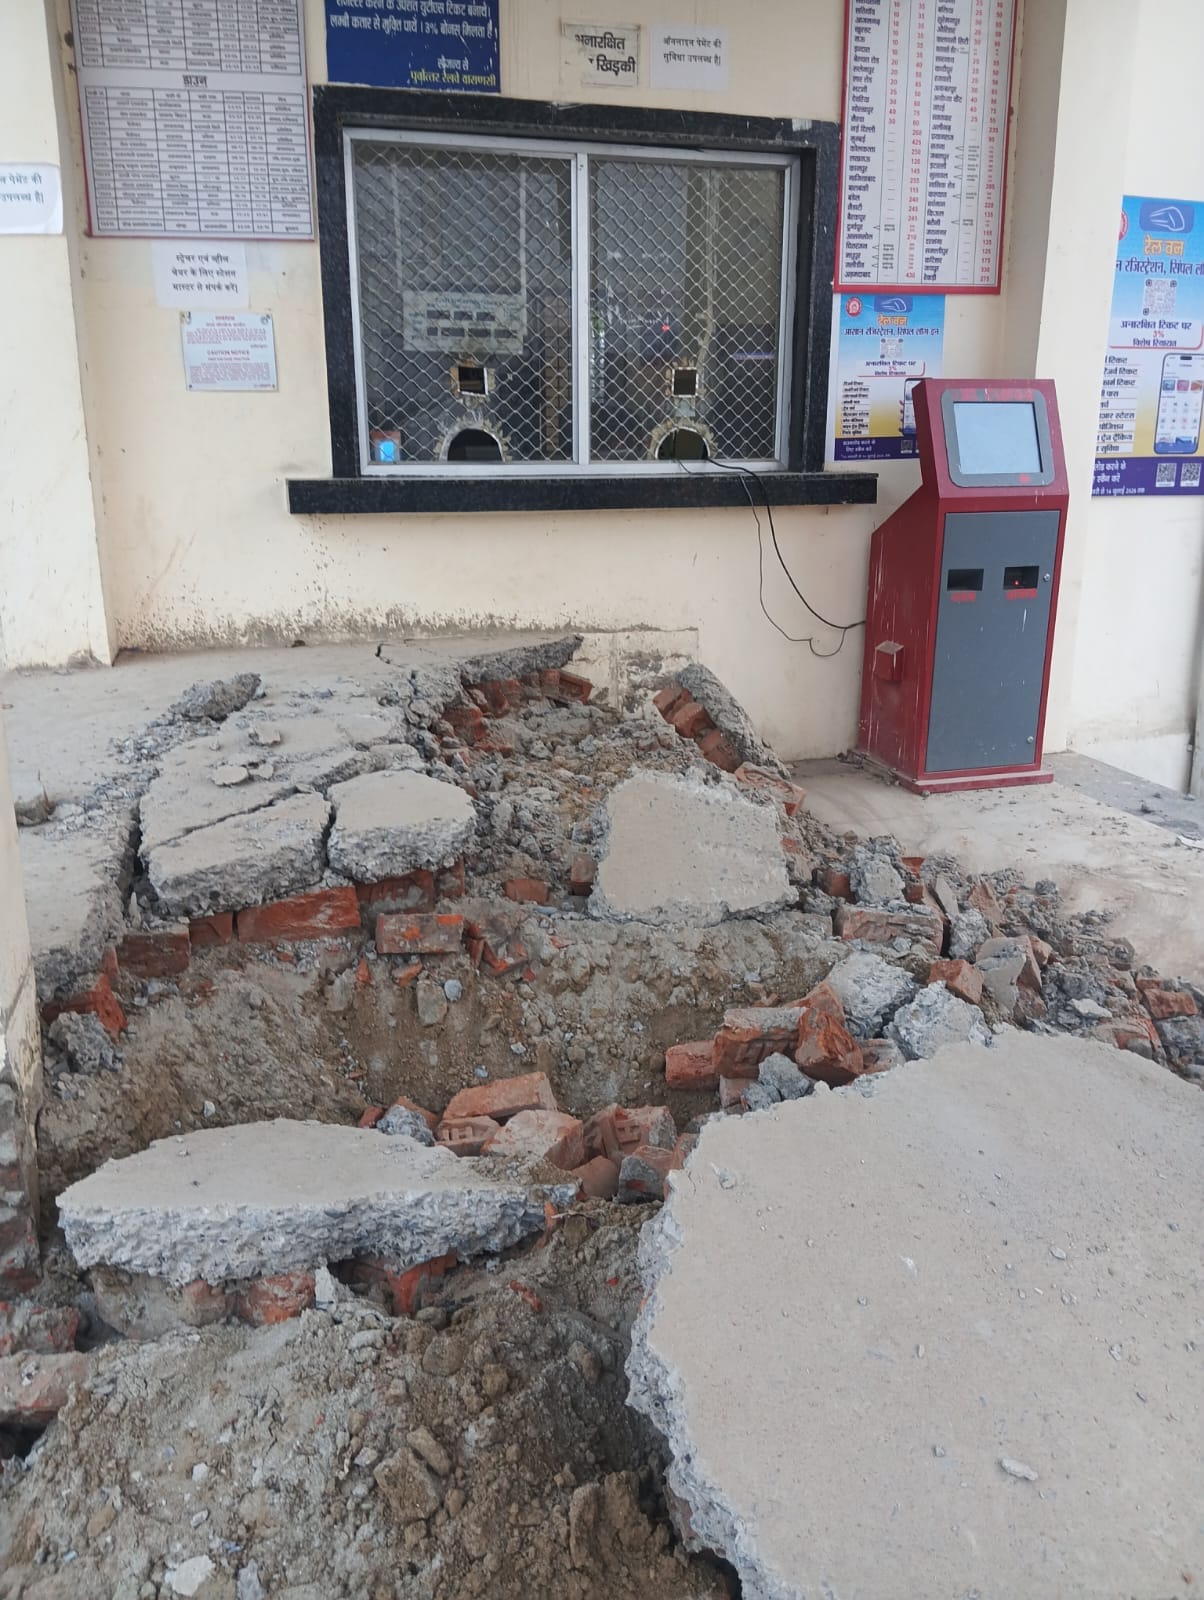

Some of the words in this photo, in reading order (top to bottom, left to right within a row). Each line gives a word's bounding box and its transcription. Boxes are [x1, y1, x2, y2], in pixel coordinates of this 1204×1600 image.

[446, 0, 466, 16] टिकट
[351, 16, 372, 30] कतार
[596, 53, 636, 76] खिड़की
